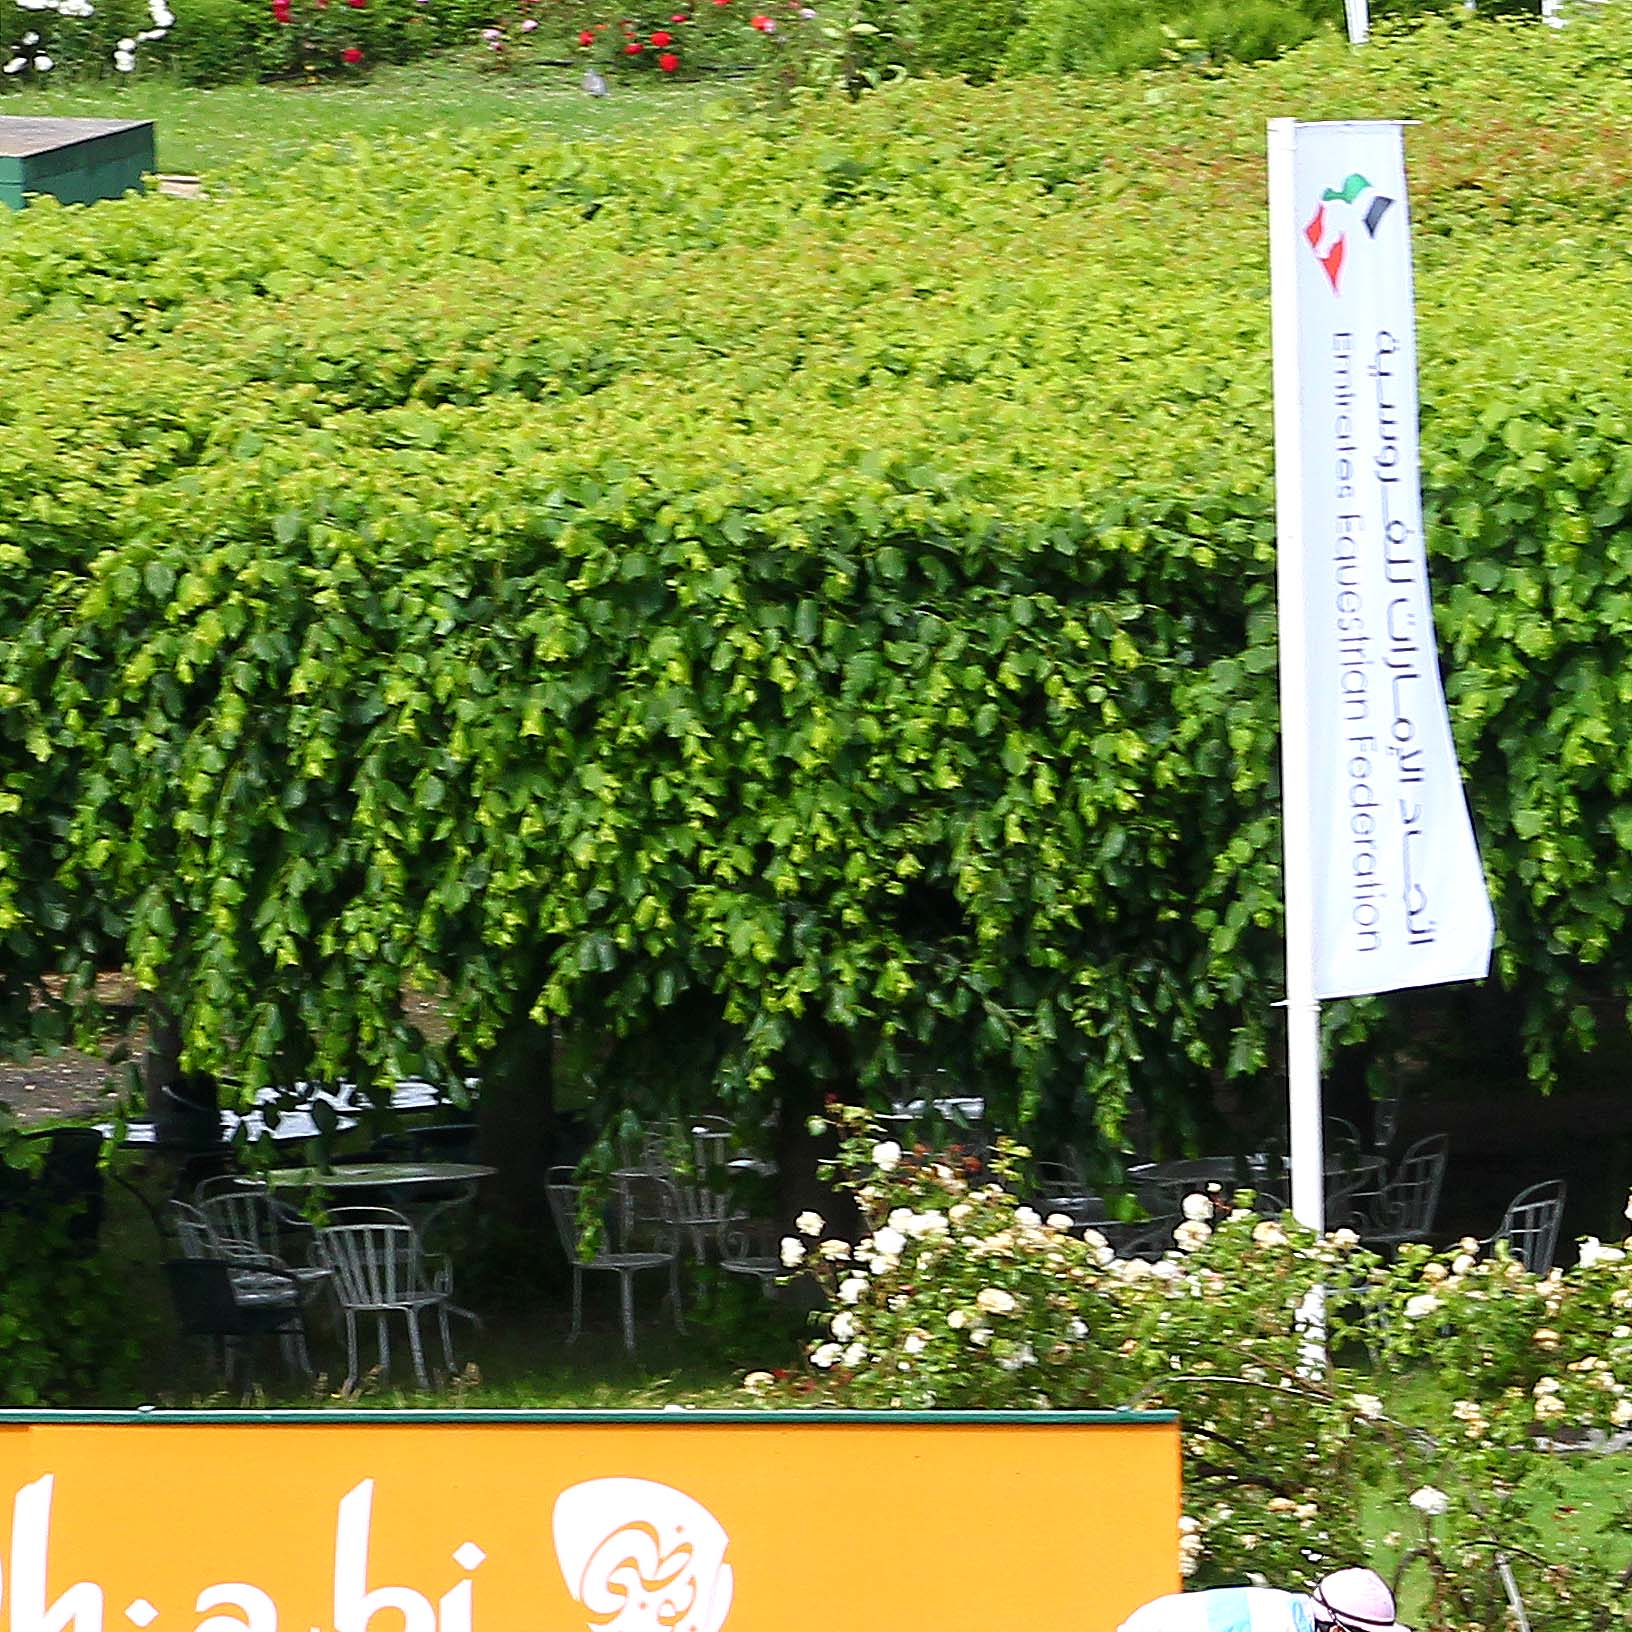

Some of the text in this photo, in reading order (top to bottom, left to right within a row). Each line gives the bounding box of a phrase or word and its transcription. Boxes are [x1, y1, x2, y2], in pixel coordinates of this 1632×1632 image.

[1332, 332, 1384, 951] Emirates Equestrian Federation
